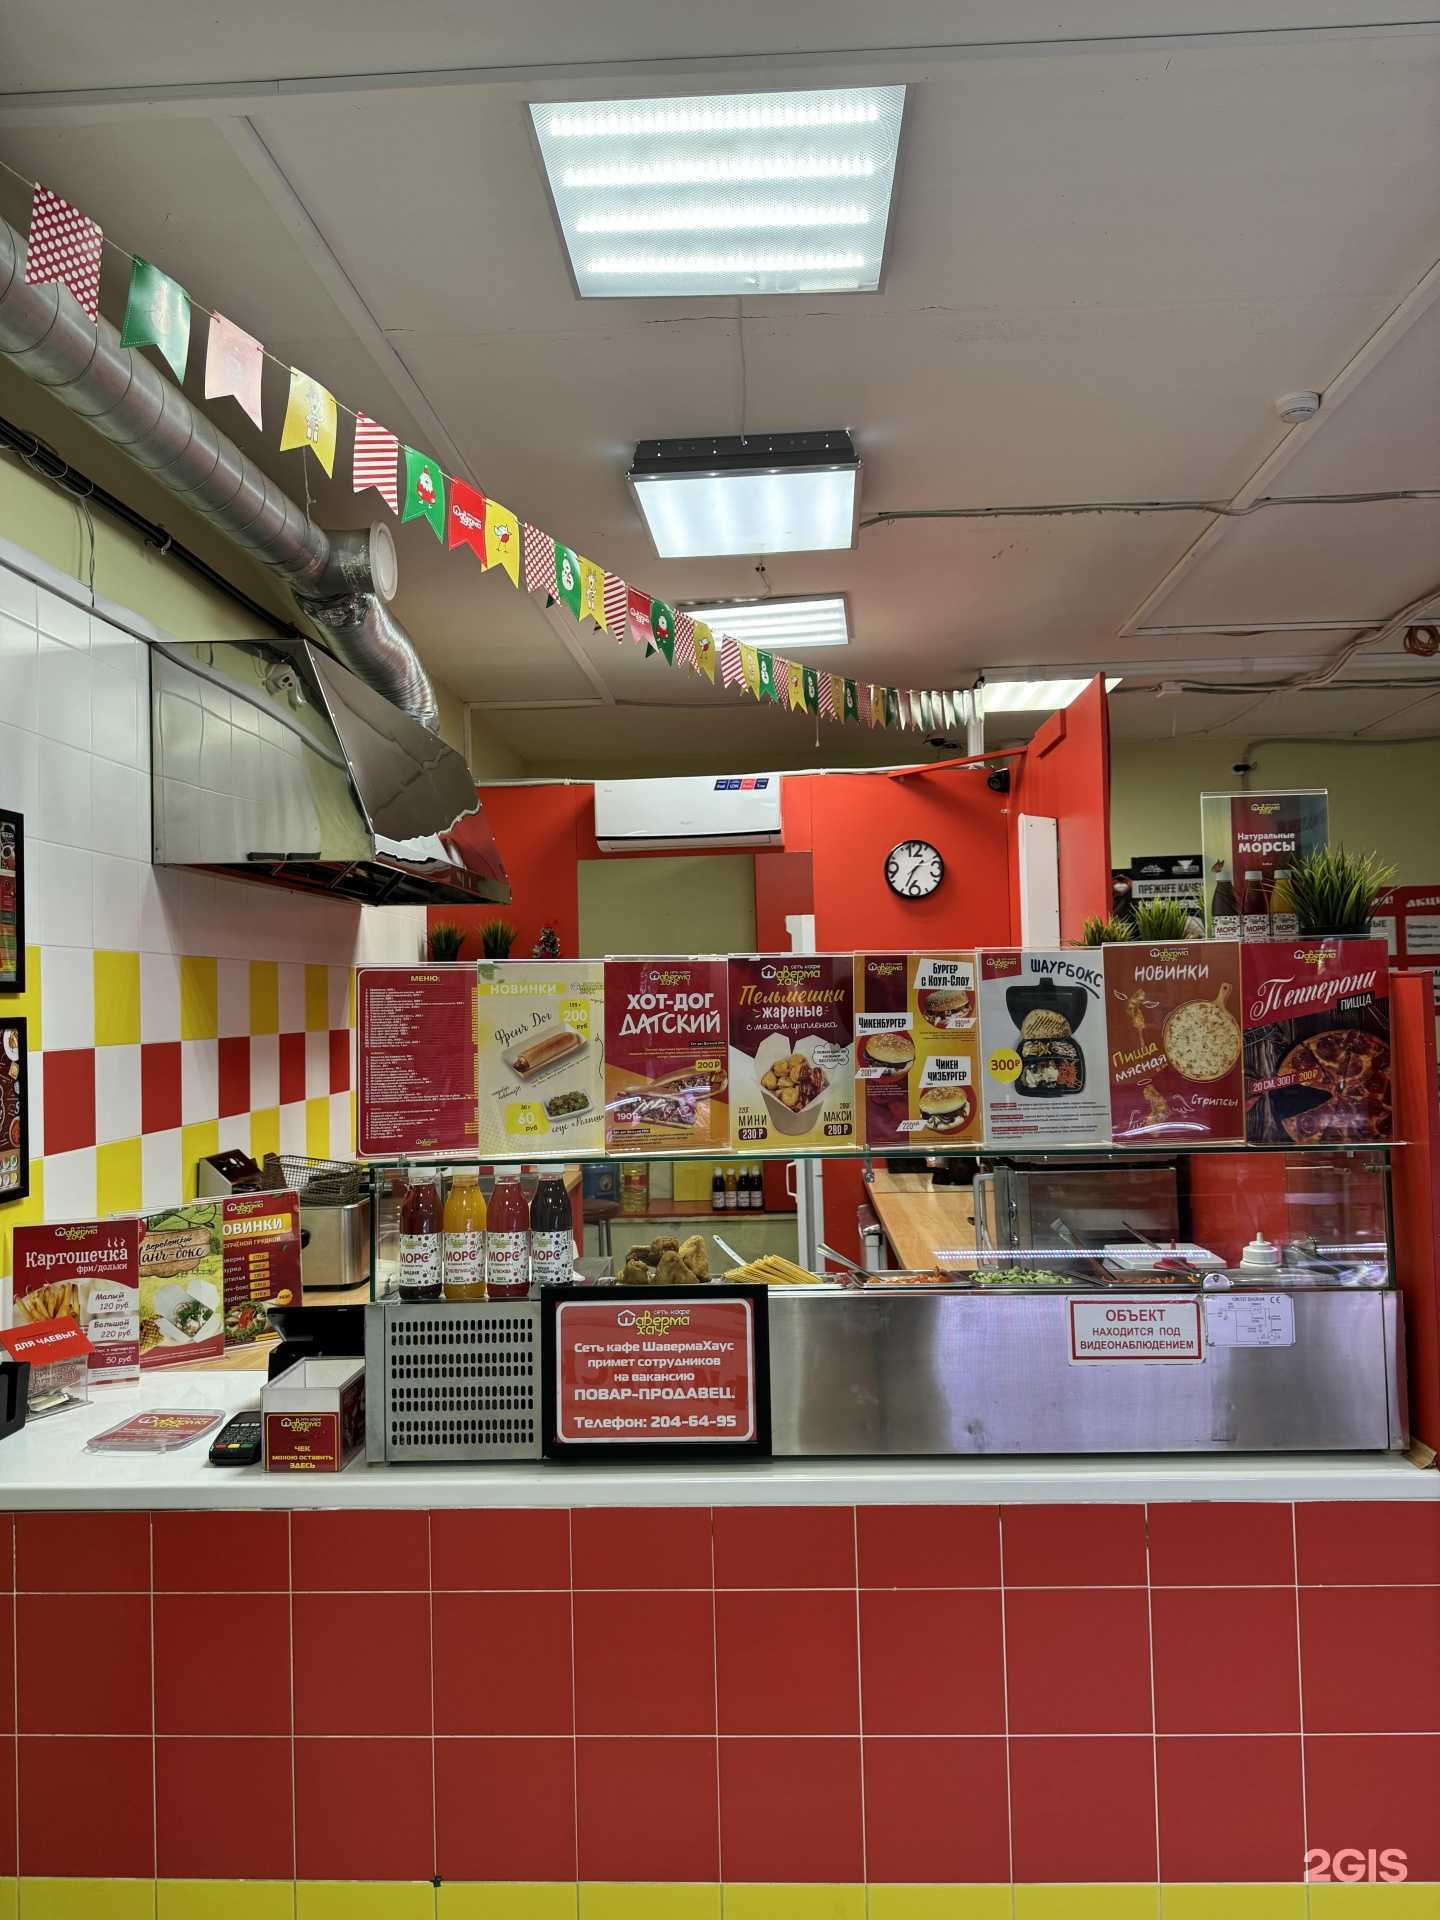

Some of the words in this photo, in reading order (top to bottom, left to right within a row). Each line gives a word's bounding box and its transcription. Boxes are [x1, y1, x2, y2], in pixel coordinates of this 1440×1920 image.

[1238, 832, 1295, 842] Натуральные
[905, 843, 923, 857] 12
[1238, 842, 1296, 856] морсы
[889, 861, 899, 879] 9
[930, 860, 941, 878] 3
[909, 879, 921, 896] 6
[932, 963, 959, 975] БУРГЕР
[1030, 958, 1104, 987] ШАУРБОКС
[1134, 963, 1209, 981] НОВИНКИ
[490, 984, 557, 994] НОВИНКИ
[739, 985, 845, 1006] Пельмешки
[1249, 970, 1377, 1021] Пепперони
[627, 992, 715, 1012] ХОТ-ДОГ
[1340, 993, 1372, 1011] ПИЦЦА
[563, 1009, 588, 1022] 200
[762, 1005, 823, 1023] жареные
[618, 1009, 721, 1036] ДАТСКИЙ
[754, 1022, 790, 1031] мясом
[1112, 1041, 1159, 1067] Пицца
[697, 1061, 714, 1069] 200
[927, 1071, 967, 1082] ЧИЗБУРГЕР
[1253, 1082, 1262, 1092] 20
[1191, 1093, 1239, 1108] Стрипсы
[738, 1114, 767, 1127] МИНИ
[823, 1110, 852, 1123] МАКСИ
[223, 1217, 283, 1236] ОВИНКИ
[25, 1247, 128, 1270] Картошечка
[445, 1250, 477, 1262] МОРС
[488, 1251, 520, 1262] МОРС
[76, 1262, 128, 1275] фри/дольки
[95, 1291, 125, 1301] Малый
[99, 1302, 114, 1310] 120
[617, 1309, 690, 1327] Шаверма
[1105, 1309, 1166, 1322] ОБЪЕКТ
[94, 1320, 130, 1329] Большой
[636, 1325, 670, 1336] хаус
[1092, 1327, 1154, 1337] НАХОДИТСЯ
[1159, 1327, 1181, 1337] ПОД
[14, 1340, 36, 1352] ДЛЯ
[36, 1330, 78, 1346] ЧАЕВЫХ
[574, 1342, 604, 1353] Сеть
[606, 1342, 640, 1355] кафе
[642, 1340, 735, 1354] ШавермаХаус
[1080, 1340, 1194, 1351] ВИДЕОНАБЛЮДЕНИЕМ
[587, 1357, 635, 1369] примет
[637, 1357, 721, 1369] сотрудников
[613, 1373, 630, 1382] на
[631, 1372, 695, 1382] вакансию
[574, 1386, 736, 1401] ПОВАР-ПРОДАВЕЦ.
[574, 1415, 648, 1430] Телефон:
[650, 1414, 737, 1428] 204-64-95
